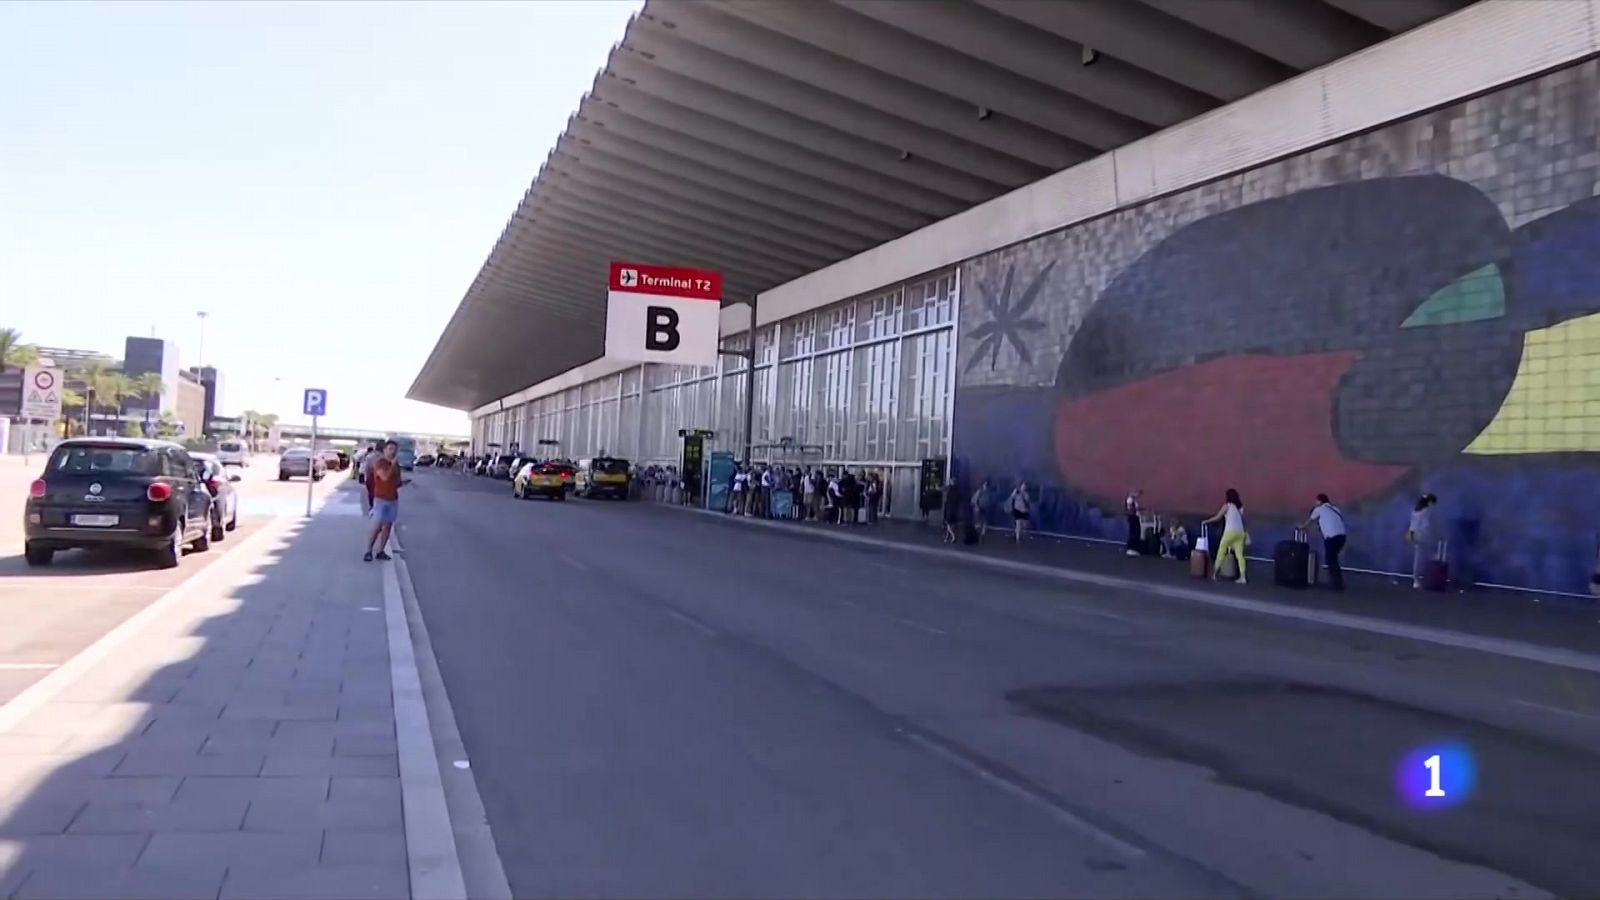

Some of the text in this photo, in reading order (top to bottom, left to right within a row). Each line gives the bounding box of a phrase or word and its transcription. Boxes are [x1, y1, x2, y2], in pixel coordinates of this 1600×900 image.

[640, 274, 711, 291] Terminal T2
[645, 305, 681, 351] B
[307, 391, 322, 412] P
